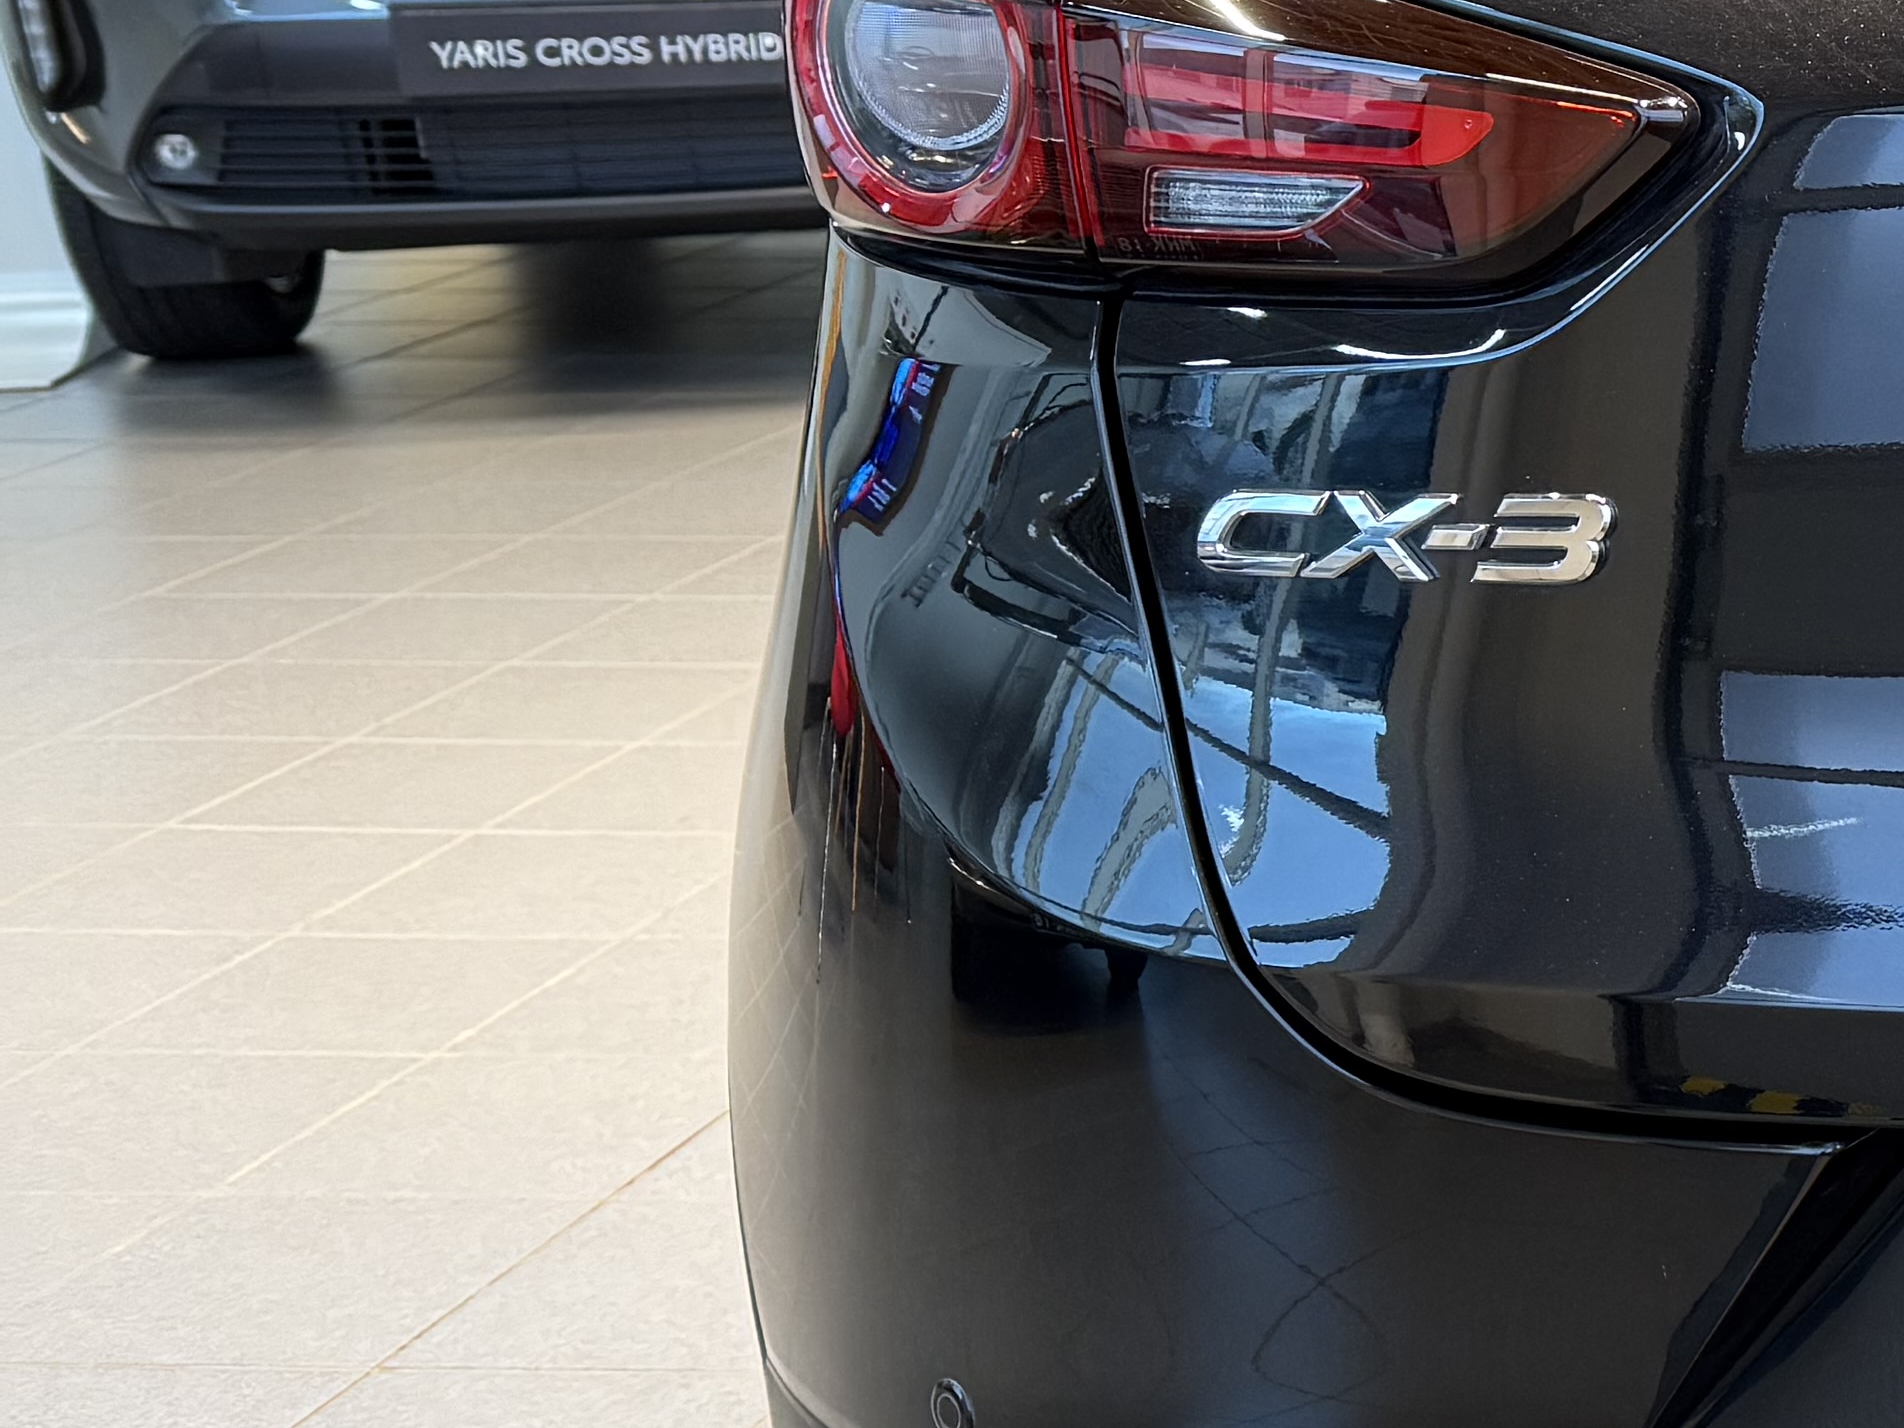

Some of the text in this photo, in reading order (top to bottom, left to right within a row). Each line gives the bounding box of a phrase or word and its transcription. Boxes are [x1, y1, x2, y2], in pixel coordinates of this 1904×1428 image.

[429, 31, 785, 70] YARIS CROSS HYBRID
[1197, 488, 1619, 585] CX-3
